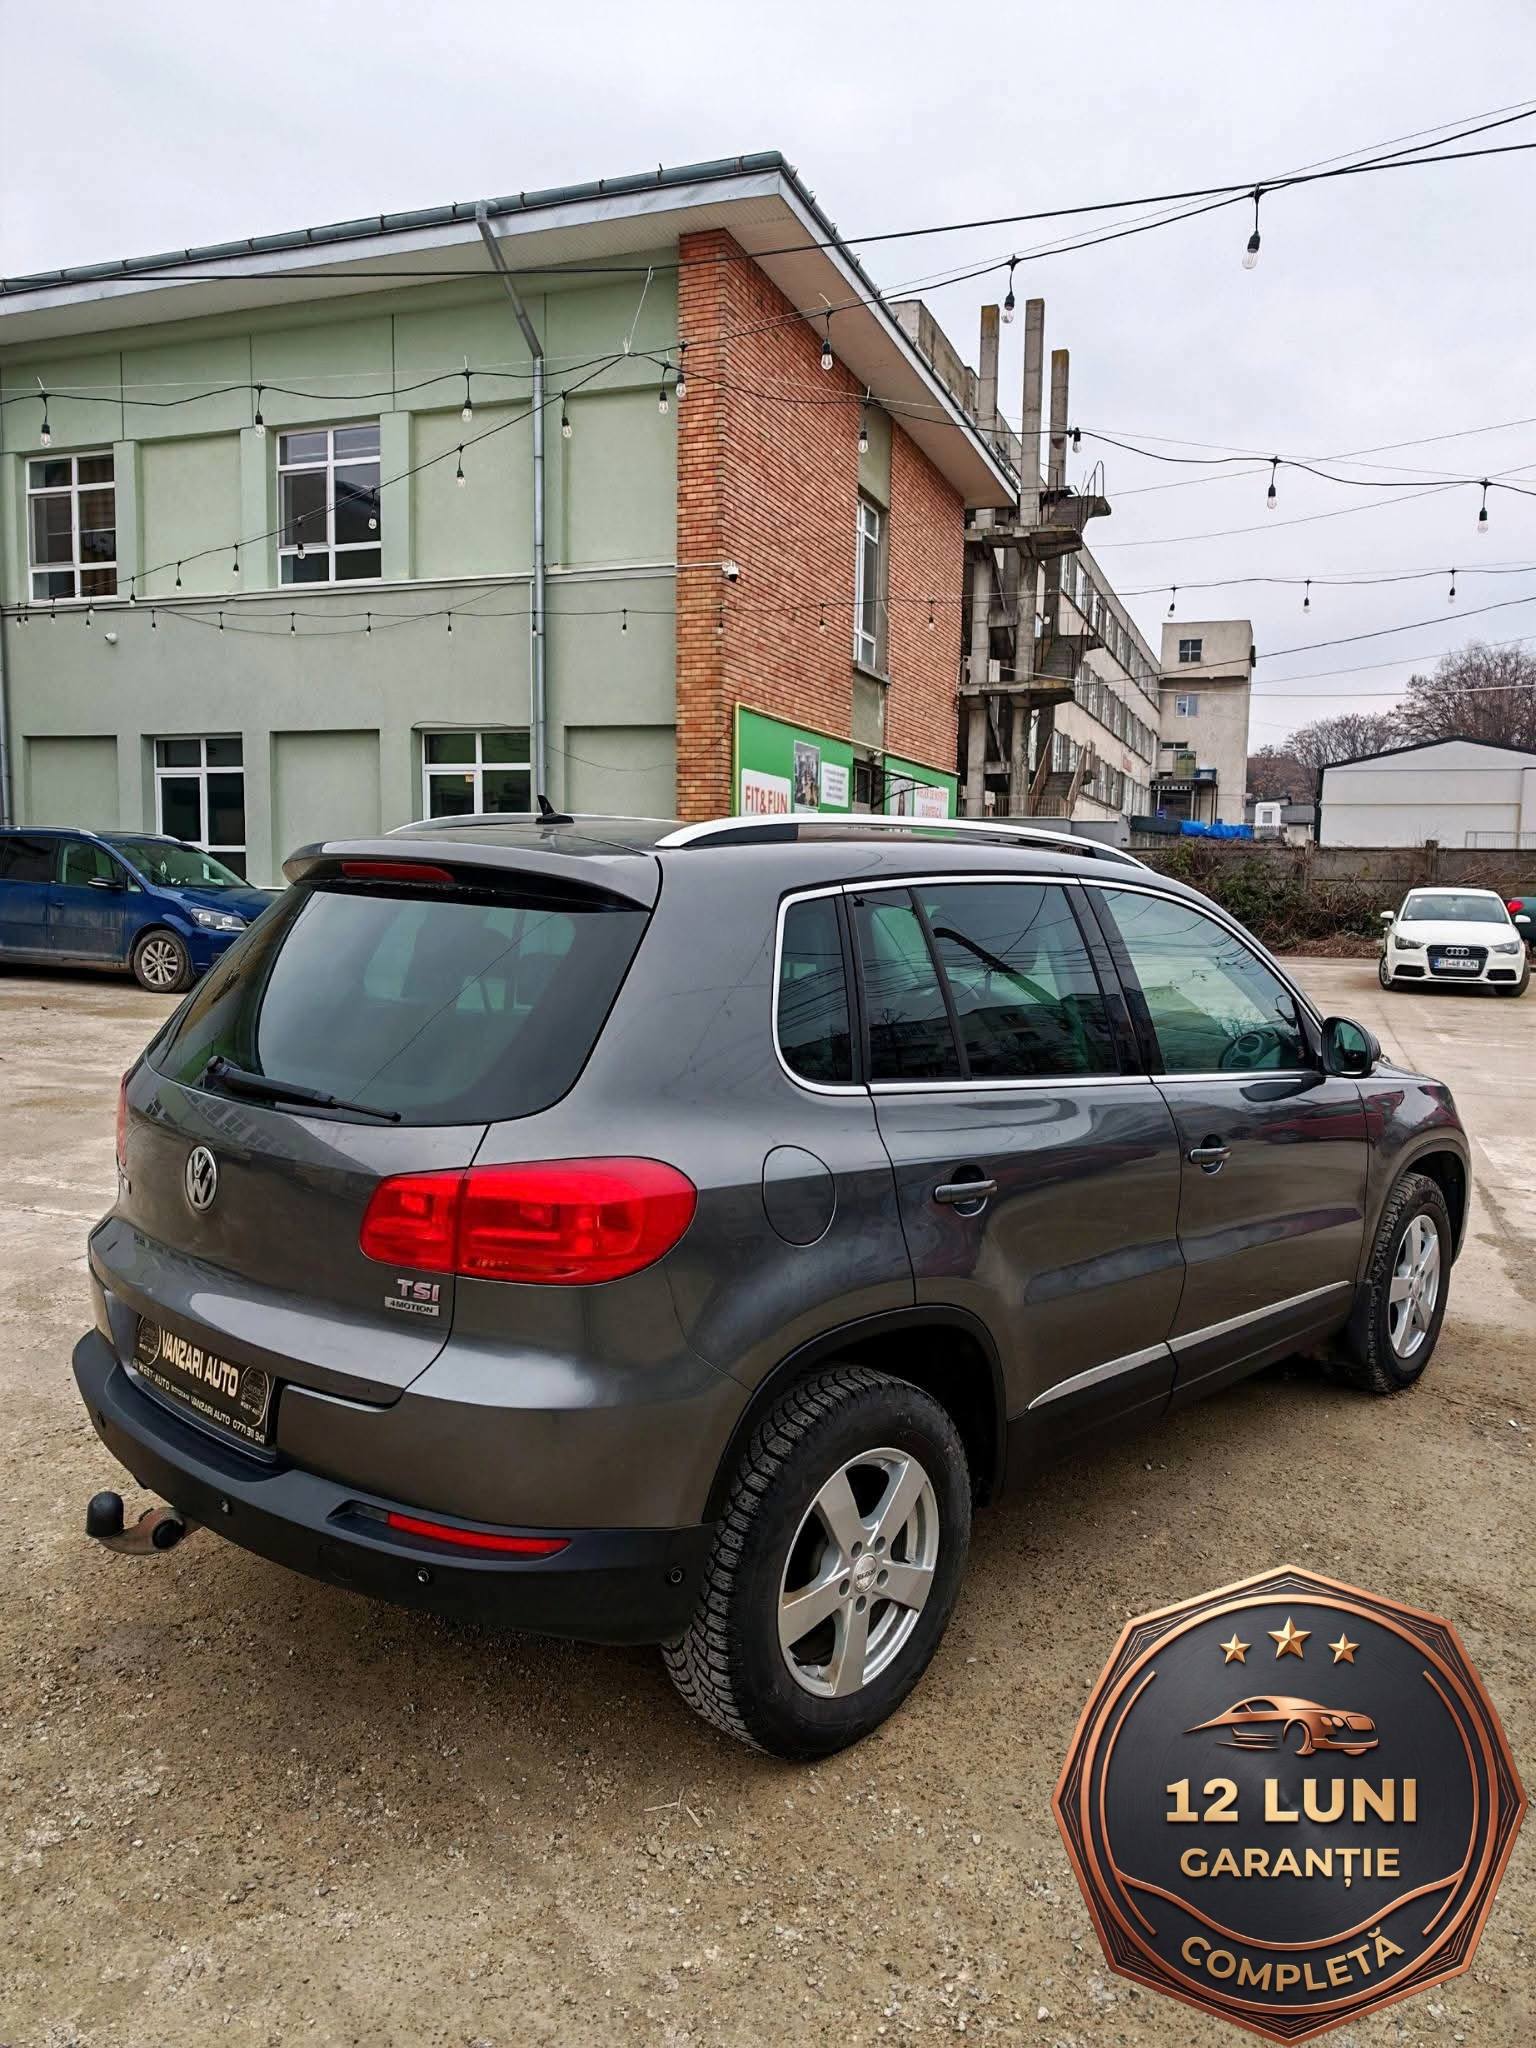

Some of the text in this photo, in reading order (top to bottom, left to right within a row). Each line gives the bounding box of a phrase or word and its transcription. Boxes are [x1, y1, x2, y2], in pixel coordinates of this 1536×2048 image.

[397, 1279, 440, 1301] TSI
[390, 1300, 433, 1313] 4MOTION
[161, 1329, 239, 1398] VANZARI AUTO
[214, 1409, 231, 1425] AUTO
